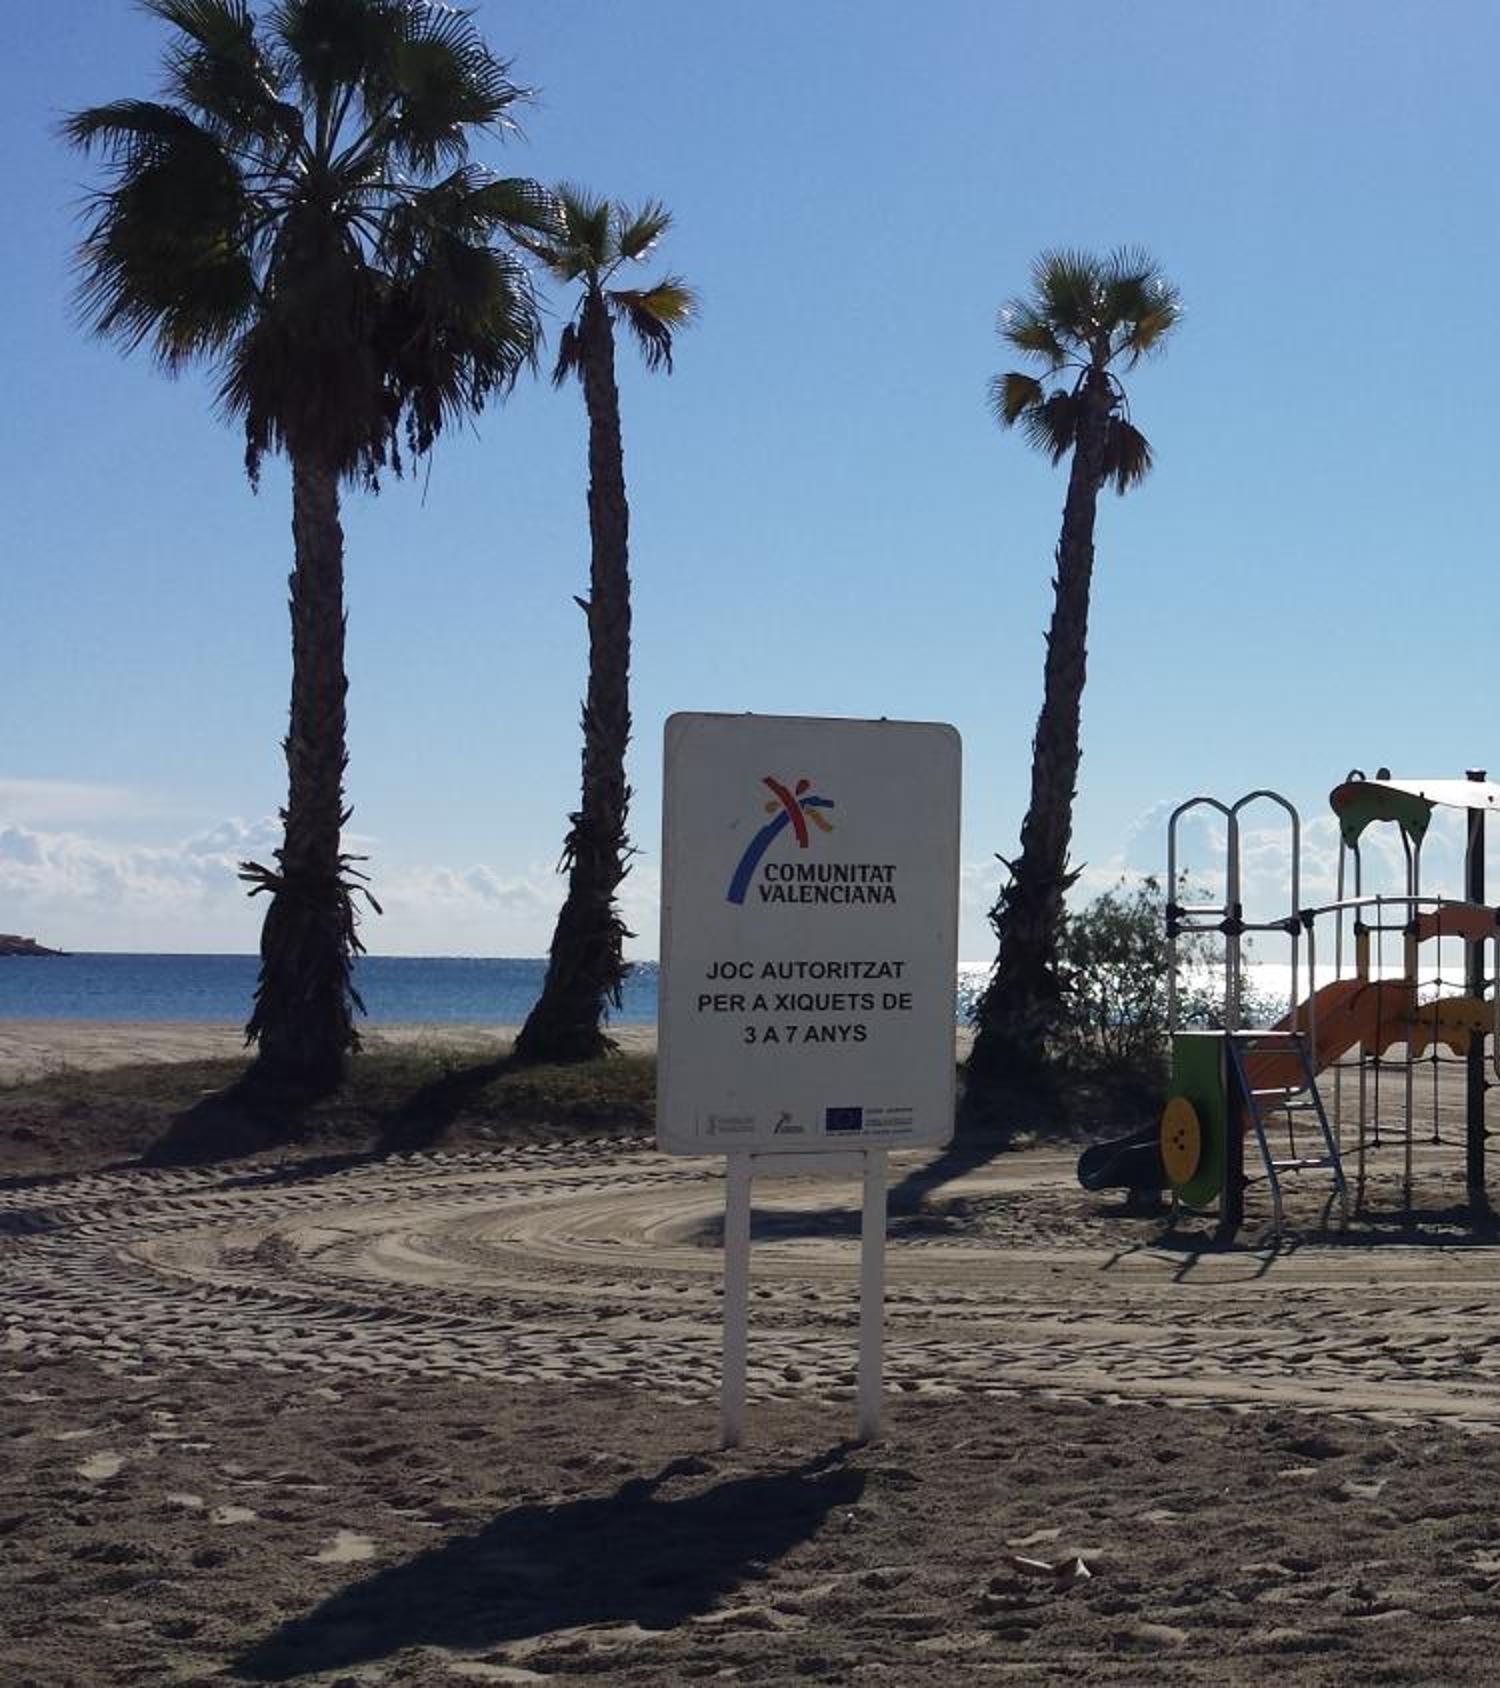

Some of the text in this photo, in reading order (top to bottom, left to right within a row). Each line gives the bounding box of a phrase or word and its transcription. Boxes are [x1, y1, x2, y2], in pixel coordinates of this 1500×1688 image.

[764, 863, 897, 883] COMUNITAT
[758, 884, 897, 905] VALENCIANA
[705, 961, 905, 980] JOC AUTORITZAT
[698, 992, 913, 1013] PER A XIQUETS DE
[744, 1024, 868, 1044] 3 A 7 ANYS
